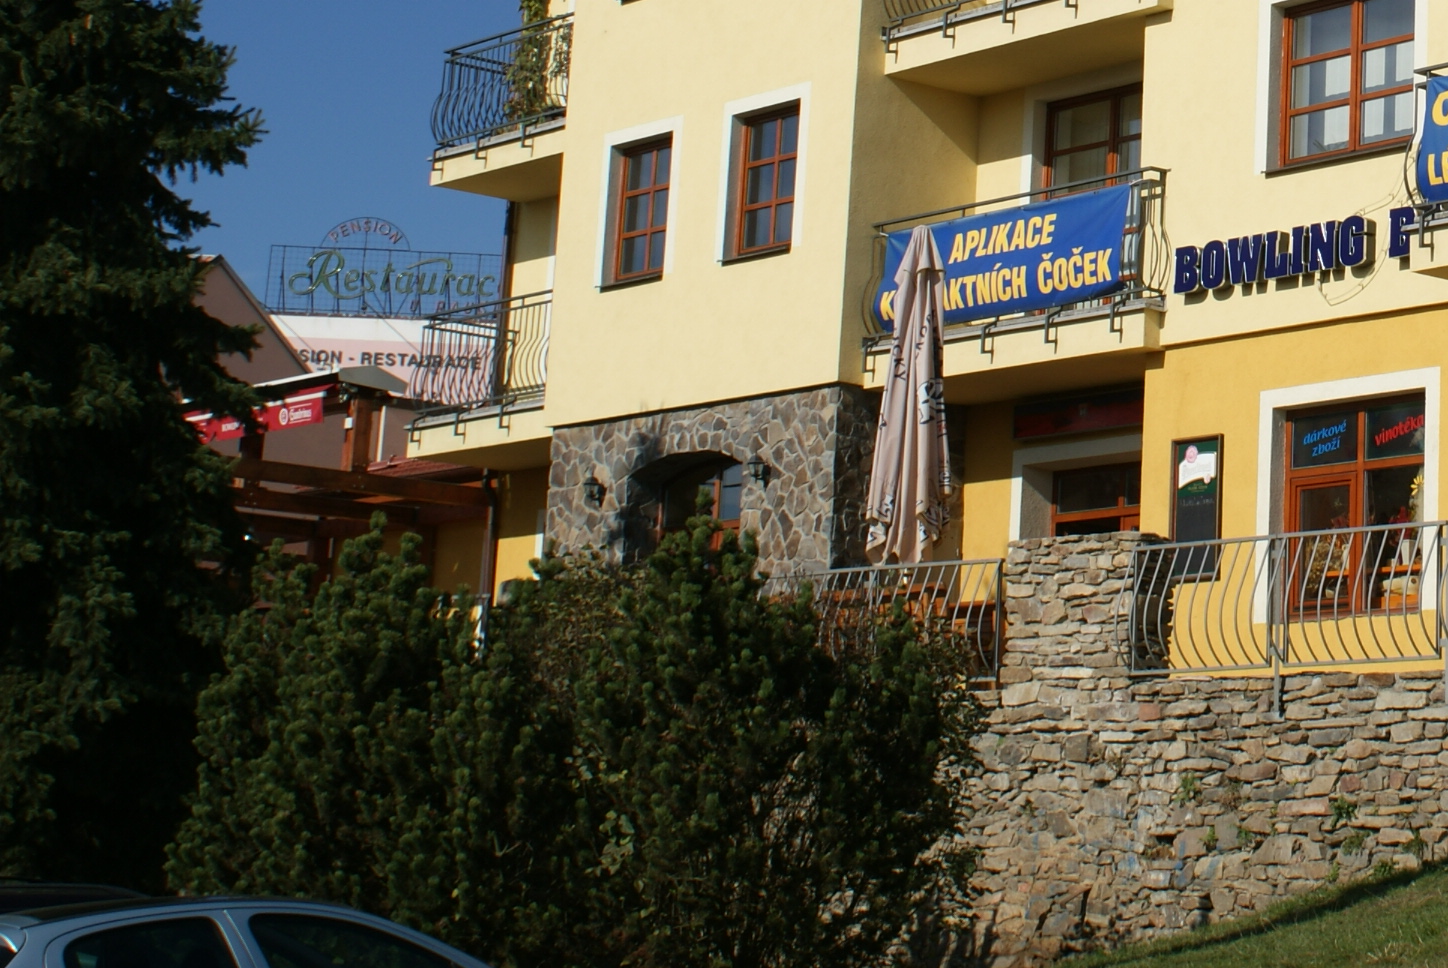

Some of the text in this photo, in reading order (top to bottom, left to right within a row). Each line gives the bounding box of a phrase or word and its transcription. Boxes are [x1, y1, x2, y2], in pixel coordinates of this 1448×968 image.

[328, 217, 404, 245] PENSION
[948, 213, 1058, 265] APLIKACE
[1174, 215, 1369, 295] BOWLING
[288, 249, 501, 300] Restaurac
[879, 245, 1113, 321] KKTNÍCH ČOČEK
[297, 348, 343, 365] SION
[1302, 419, 1347, 445] dárkové
[1311, 436, 1341, 457] zboží
[1374, 414, 1424, 447] vinotéka
